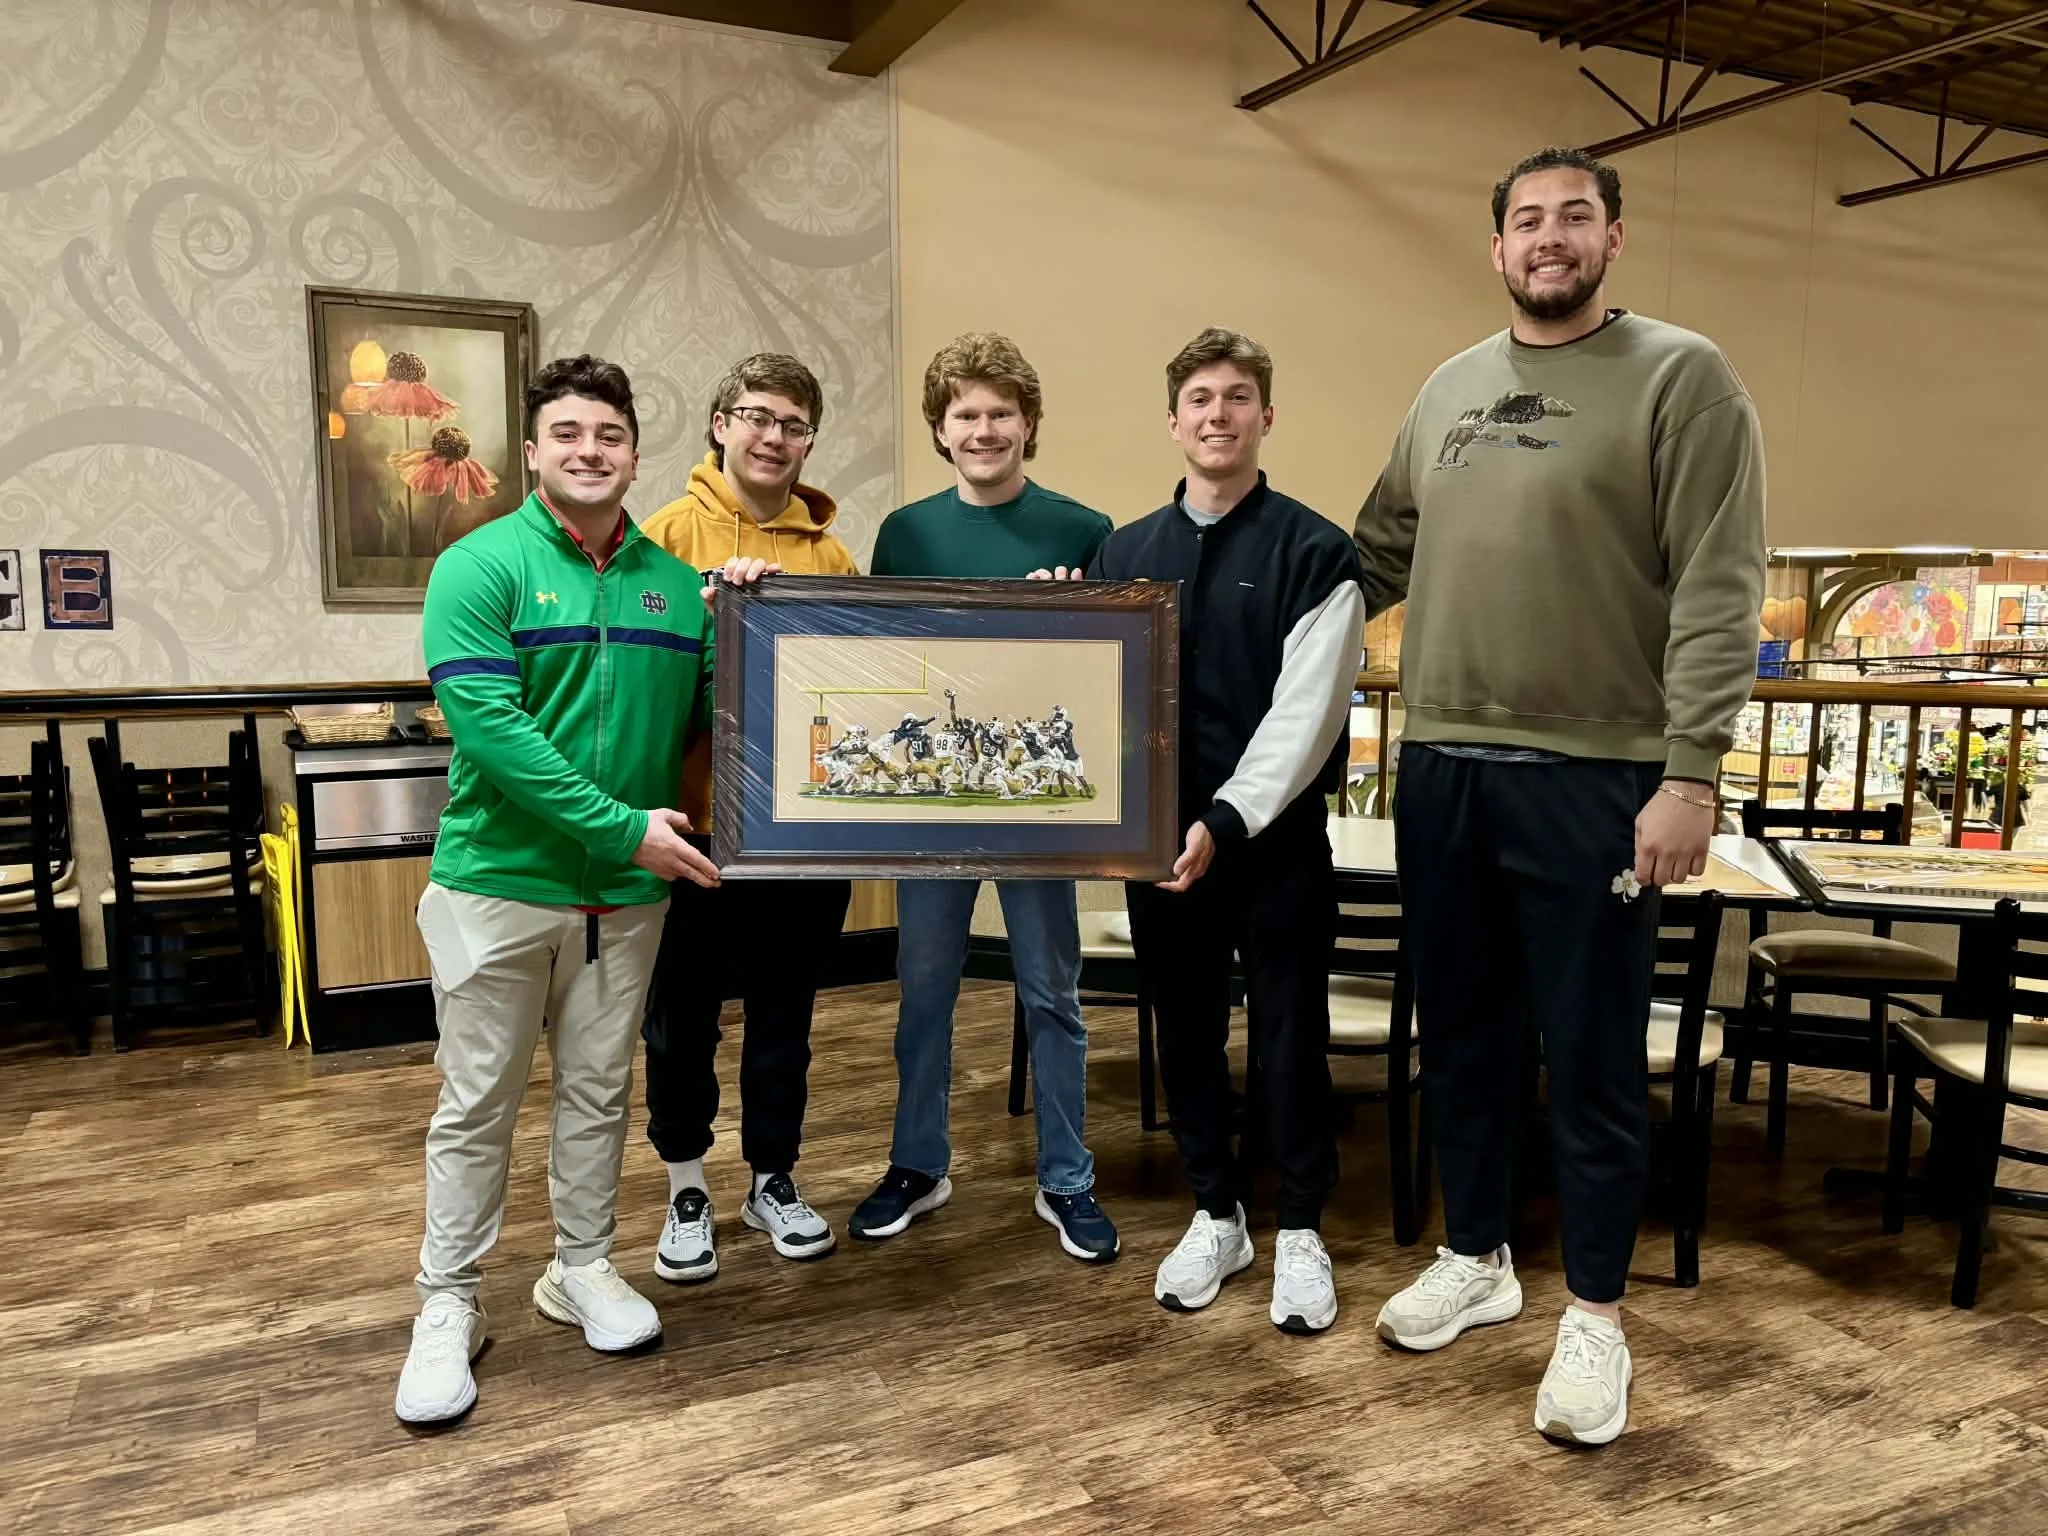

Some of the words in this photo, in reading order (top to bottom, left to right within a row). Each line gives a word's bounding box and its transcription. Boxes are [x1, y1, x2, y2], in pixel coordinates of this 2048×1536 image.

[45, 556, 108, 623] E
[912, 741, 923, 753] 91
[936, 739, 948, 750] 98
[983, 743, 997, 755] 28
[400, 834, 436, 842] WASTE
